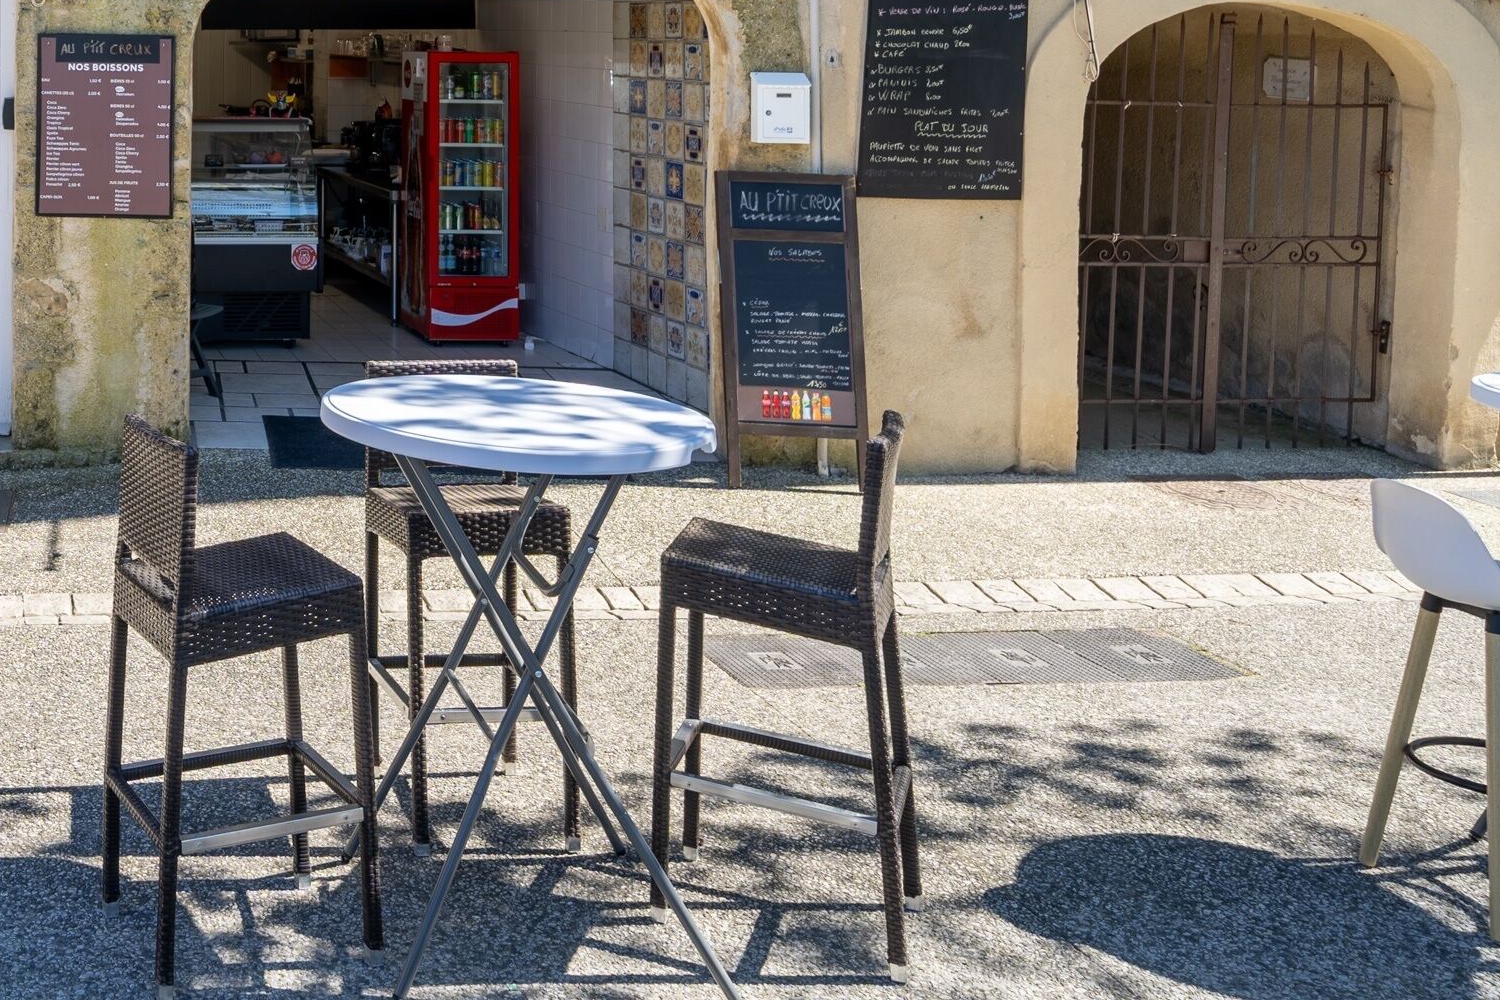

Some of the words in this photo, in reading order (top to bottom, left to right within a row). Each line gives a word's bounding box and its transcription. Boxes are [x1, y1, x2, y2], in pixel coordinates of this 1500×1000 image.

[60, 43, 76, 55] AU
[882, 41, 920, 49] CHOCOLAT
[924, 42, 949, 50] CHAUD
[68, 63, 90, 72] NOS
[92, 63, 145, 73] BOISSONS
[878, 90, 911, 101] WRAP
[915, 120, 939, 132] PLAT
[942, 123, 955, 133] DU
[962, 123, 989, 133] JOUR
[740, 190, 759, 212] AU
[768, 246, 782, 256] NOS
